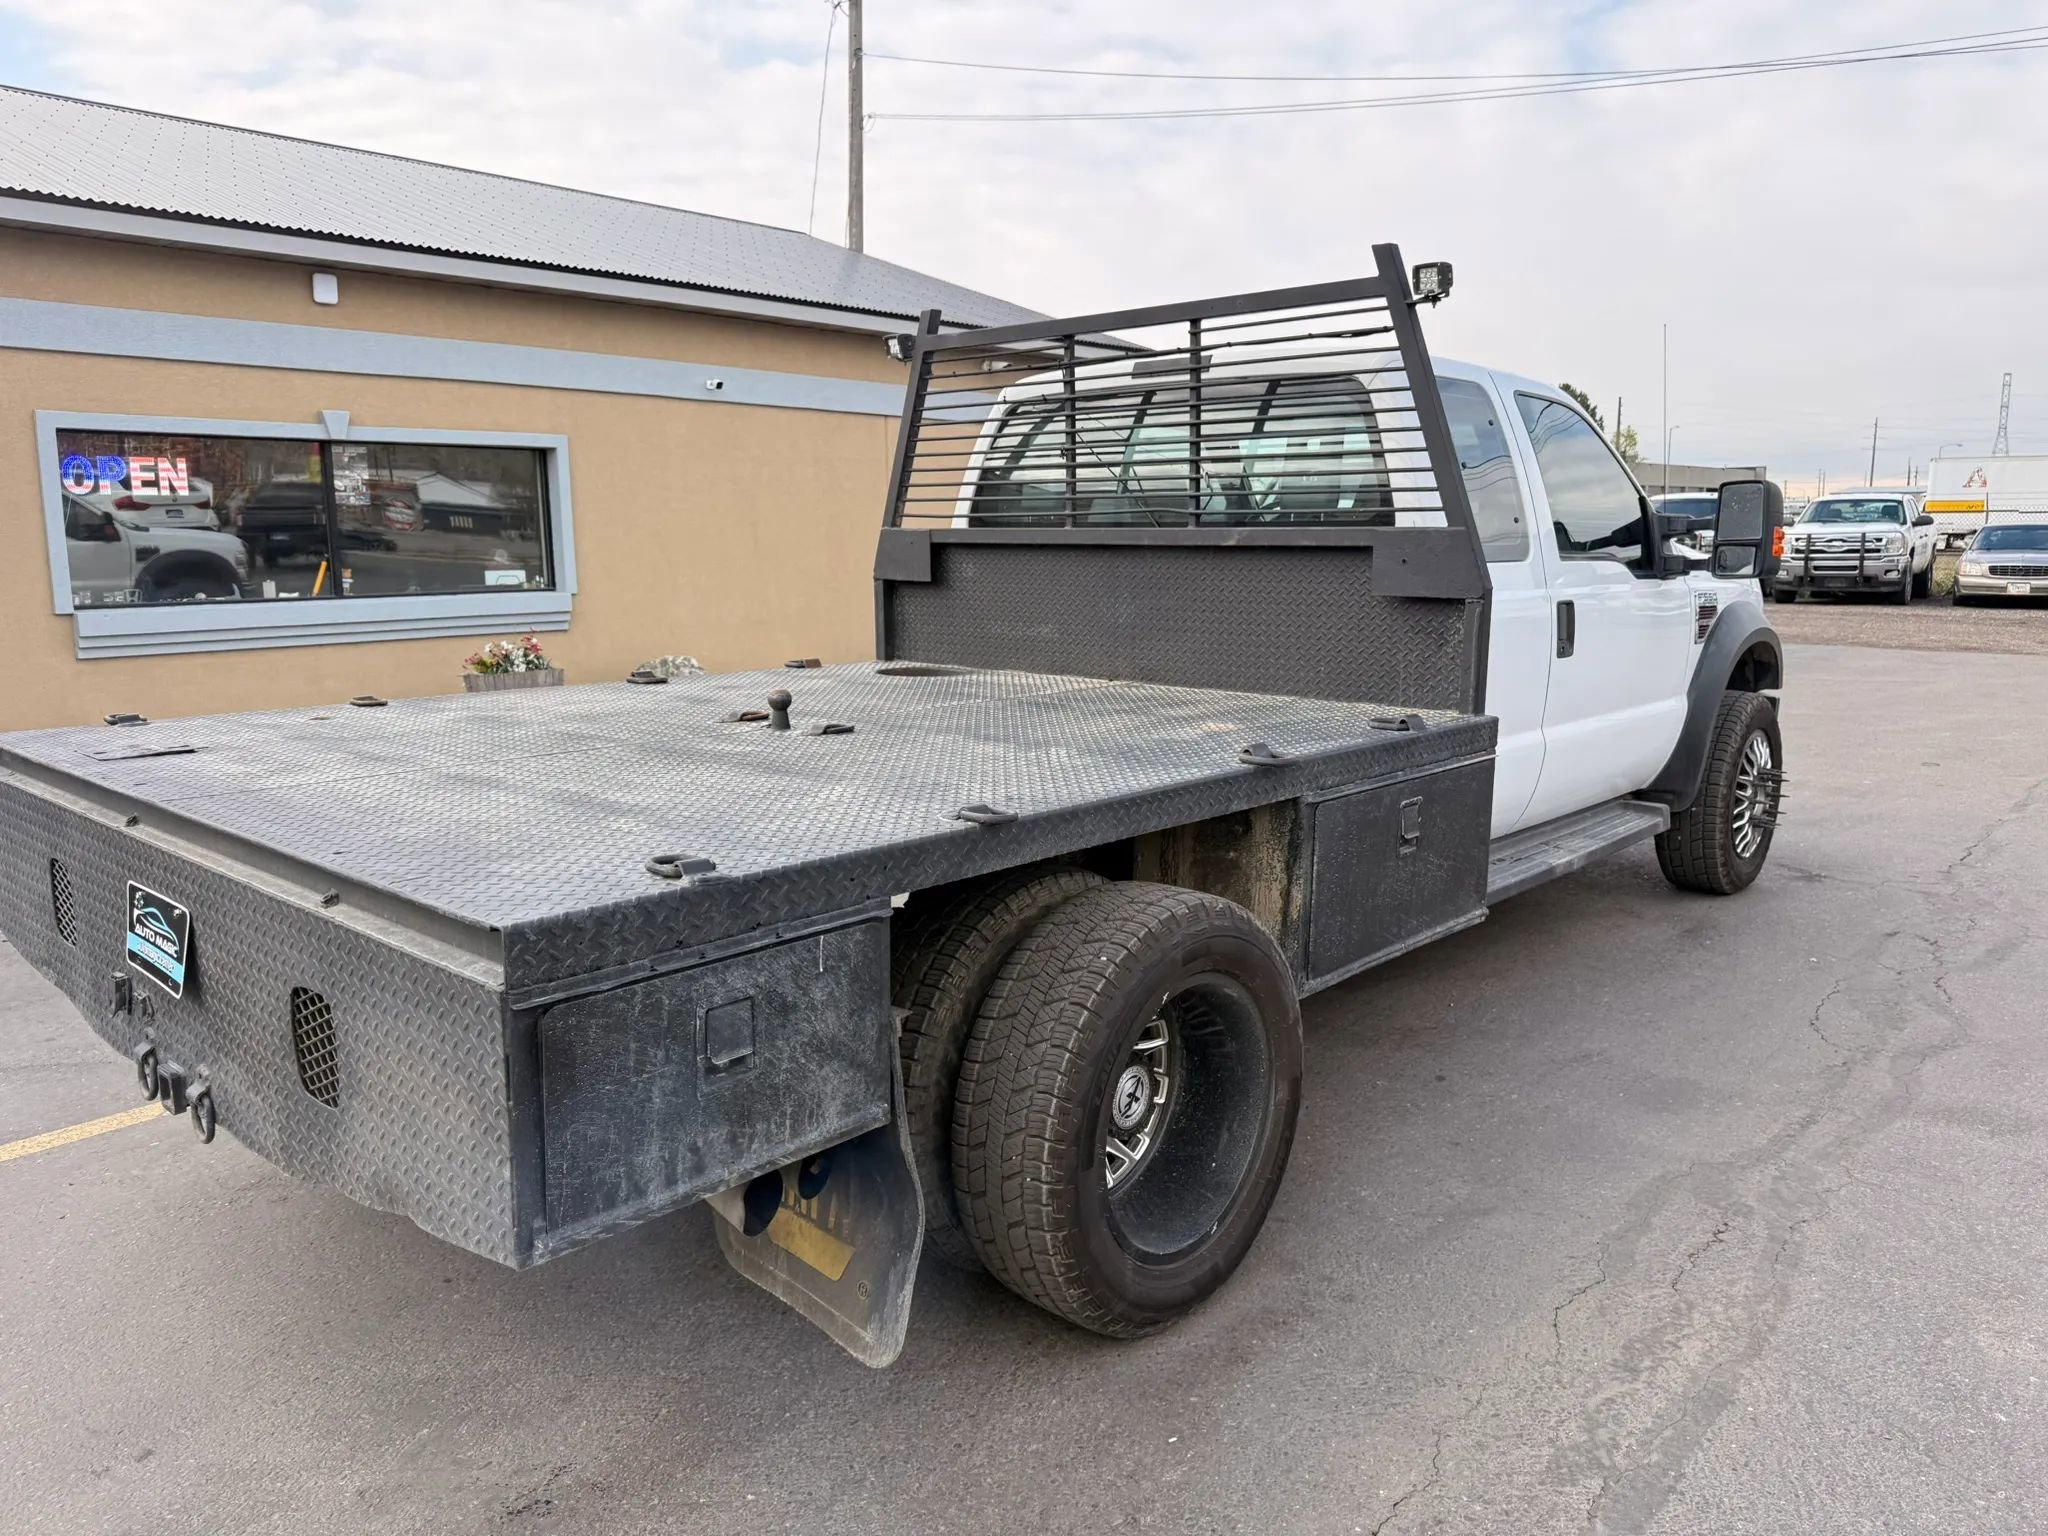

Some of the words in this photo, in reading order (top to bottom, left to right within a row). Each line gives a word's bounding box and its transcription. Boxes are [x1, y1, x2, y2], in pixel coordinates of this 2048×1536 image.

[61, 455, 189, 495] OPEN
[135, 923, 155, 942] AUTO
[155, 935, 178, 958] MAGIC
